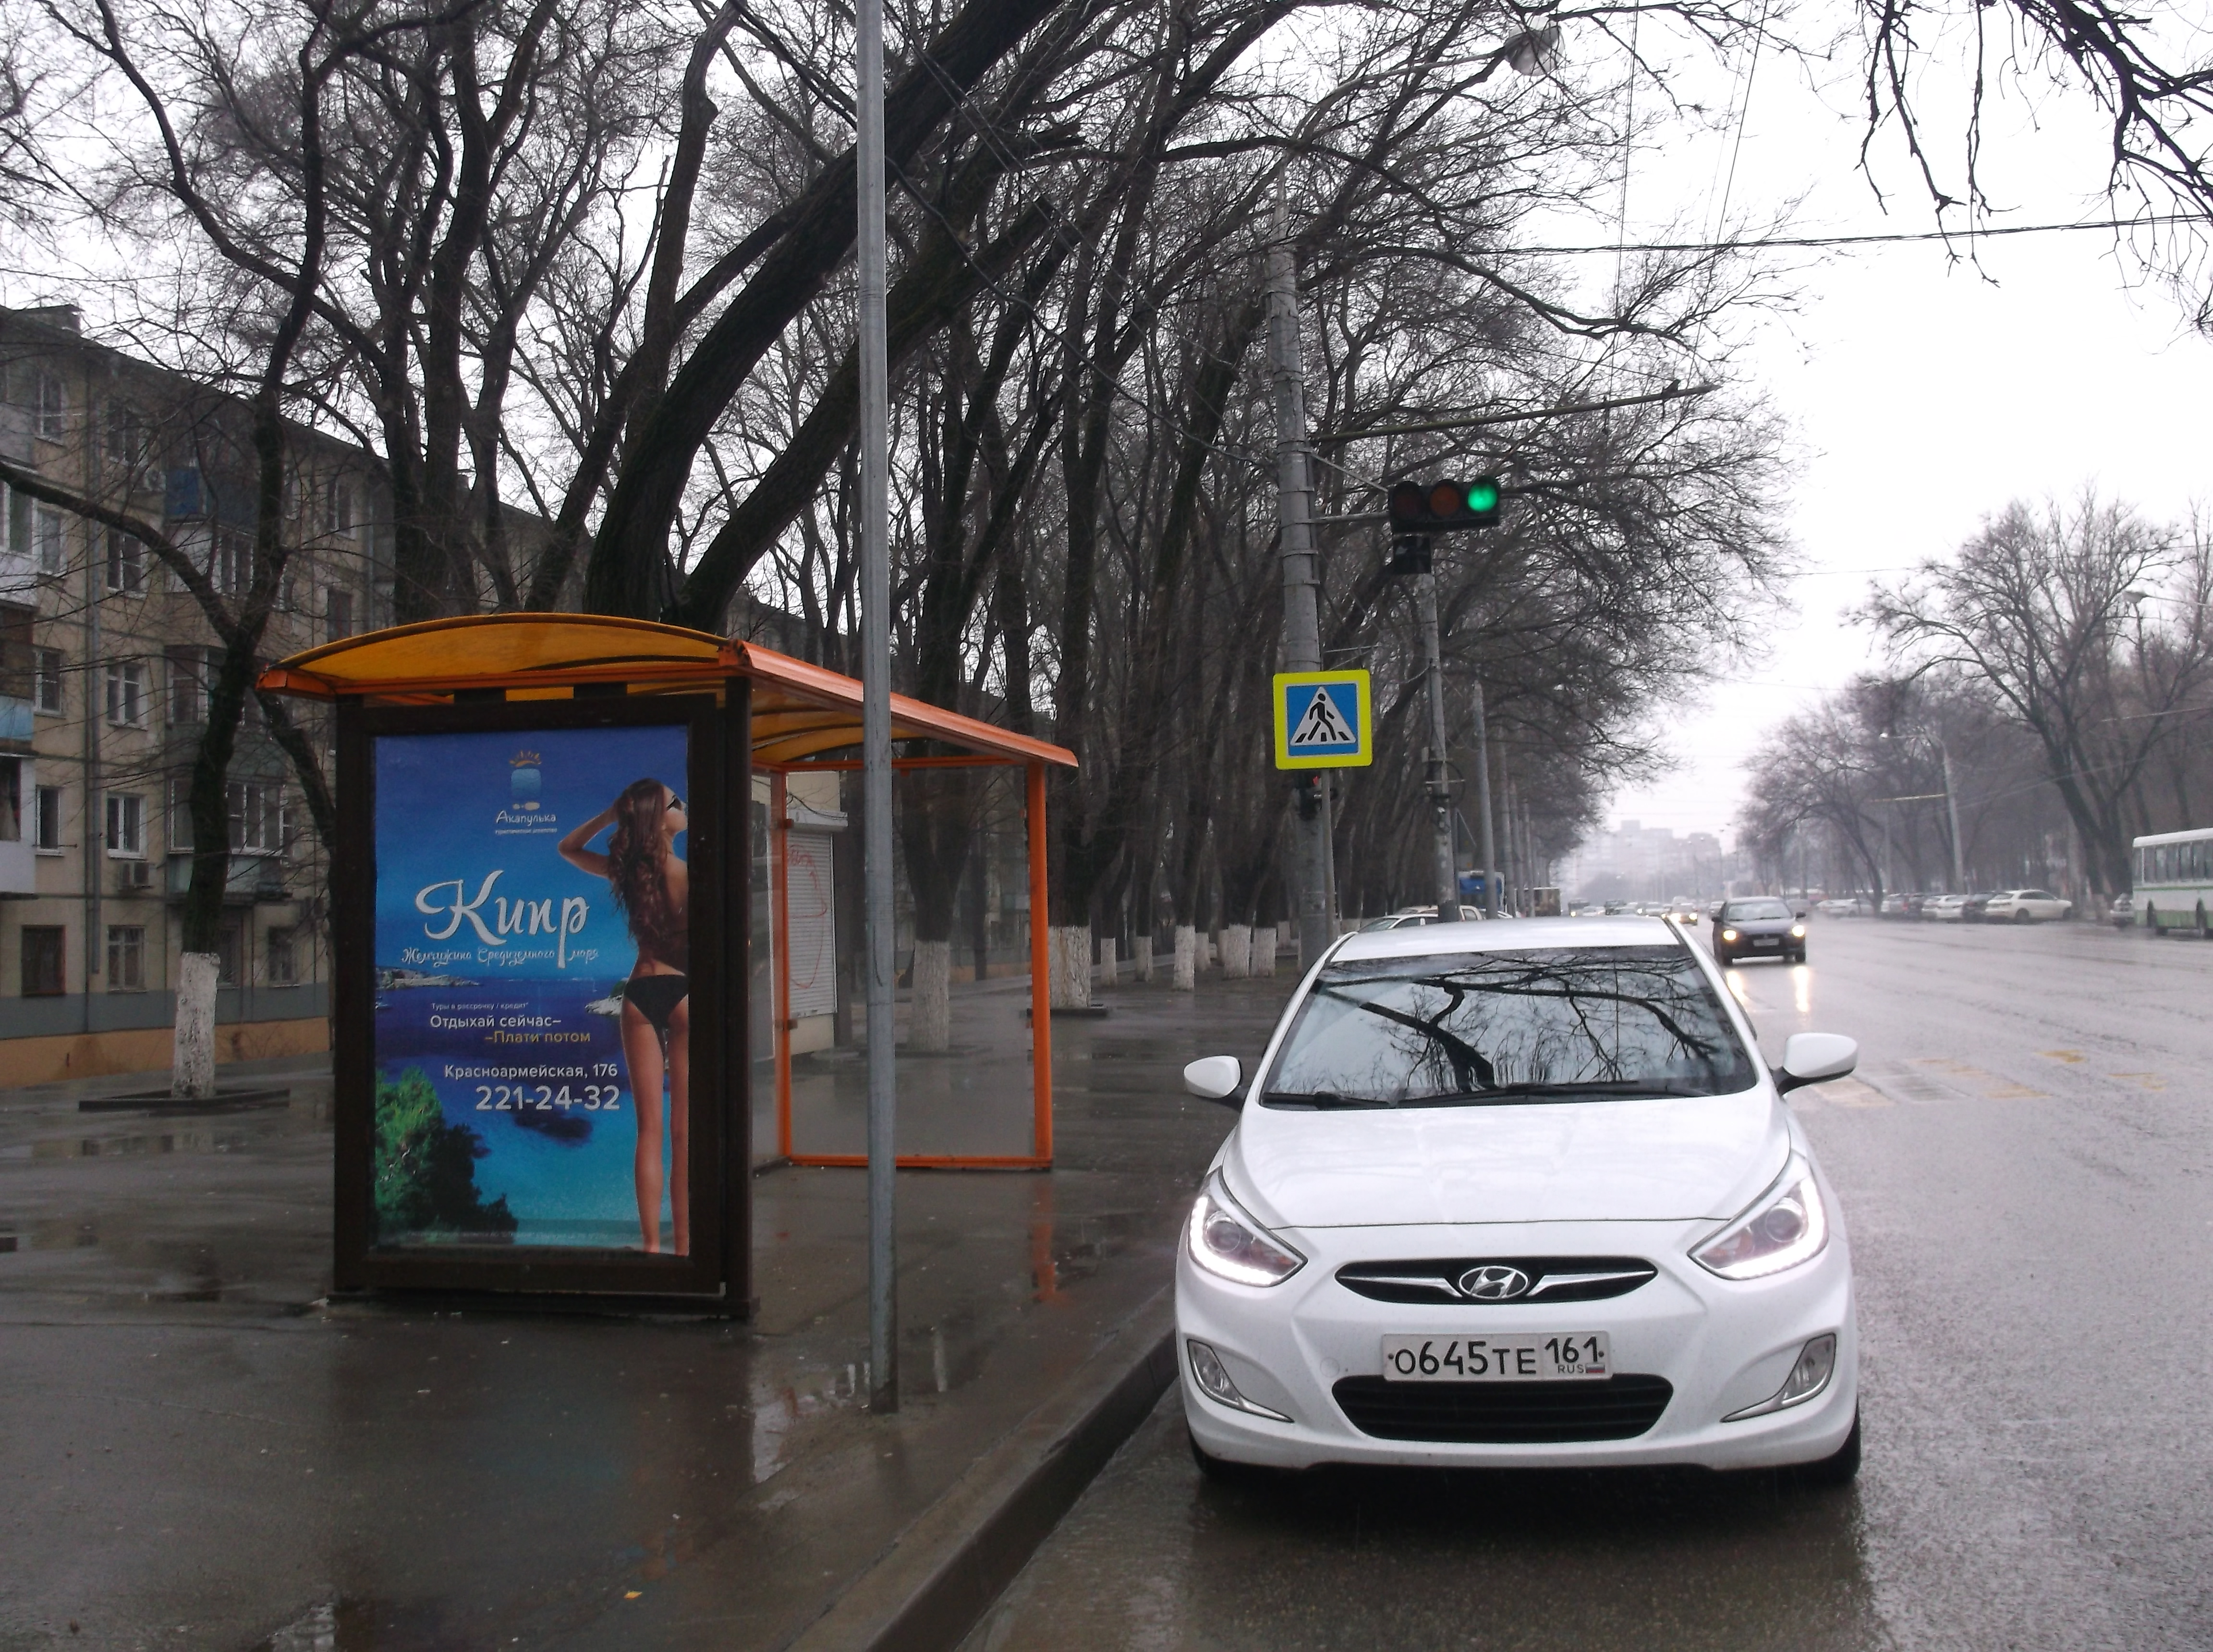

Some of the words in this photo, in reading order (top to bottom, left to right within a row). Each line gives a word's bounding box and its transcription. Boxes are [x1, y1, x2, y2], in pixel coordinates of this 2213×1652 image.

[496, 810, 557, 826] Акапулька
[415, 870, 590, 969] Кипр
[430, 1015, 495, 1029] Отдыхай
[545, 1032, 591, 1043] потом
[445, 1064, 588, 1080] Красноармейская,
[592, 1063, 618, 1077] 176
[475, 1084, 620, 1110] 221-24-32
[1544, 1336, 1598, 1364] 161
[1557, 1364, 1584, 1374] RUS
